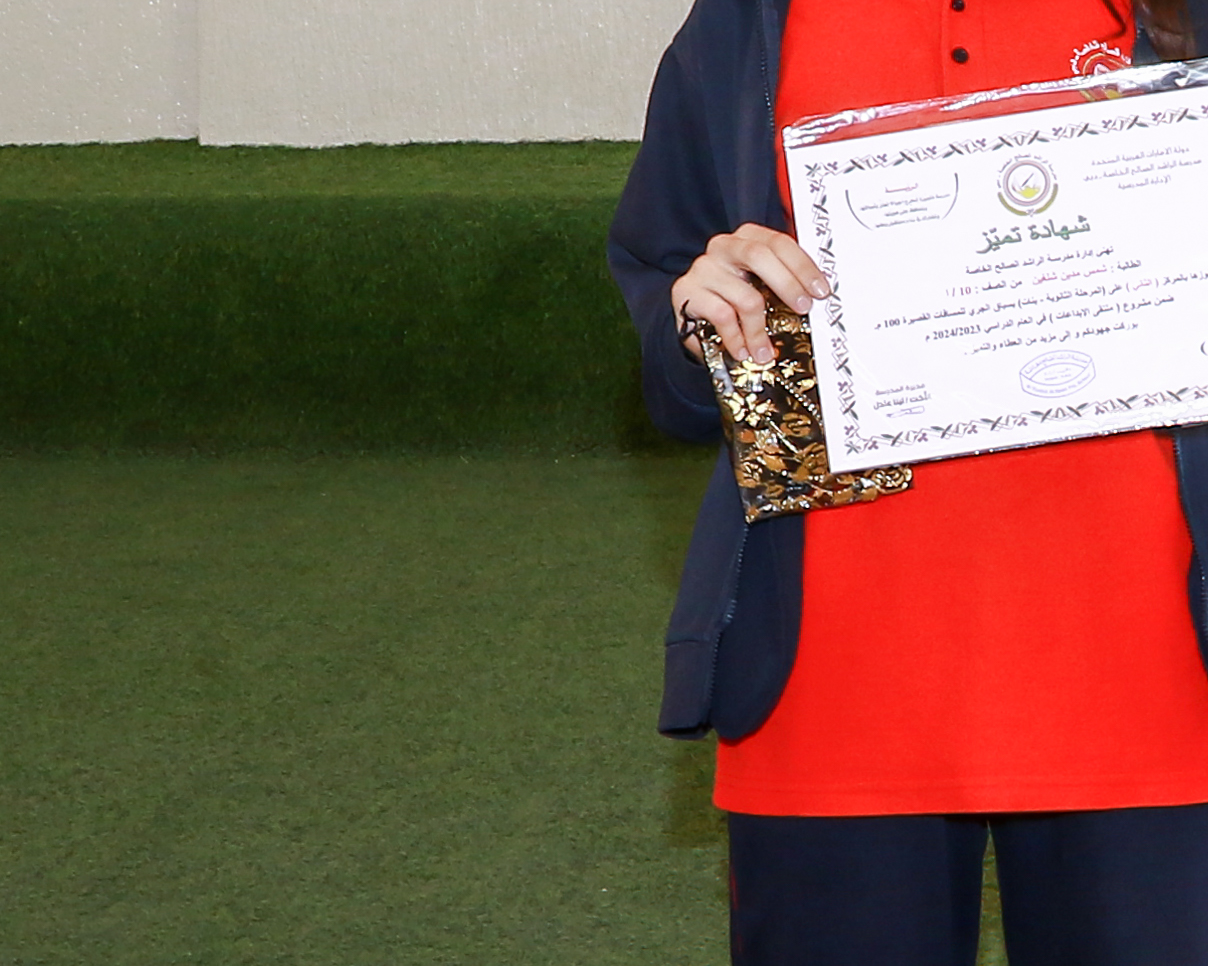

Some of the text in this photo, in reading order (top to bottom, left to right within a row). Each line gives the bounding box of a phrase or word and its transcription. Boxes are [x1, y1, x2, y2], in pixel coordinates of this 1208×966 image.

[1028, 215, 1091, 240] شهادة
[1047, 253, 1074, 263] مدرسة
[965, 264, 992, 275] الخاصة
[995, 260, 1019, 274] الصالح
[884, 318, 900, 329] 100
[933, 324, 982, 340] 2024/2023
